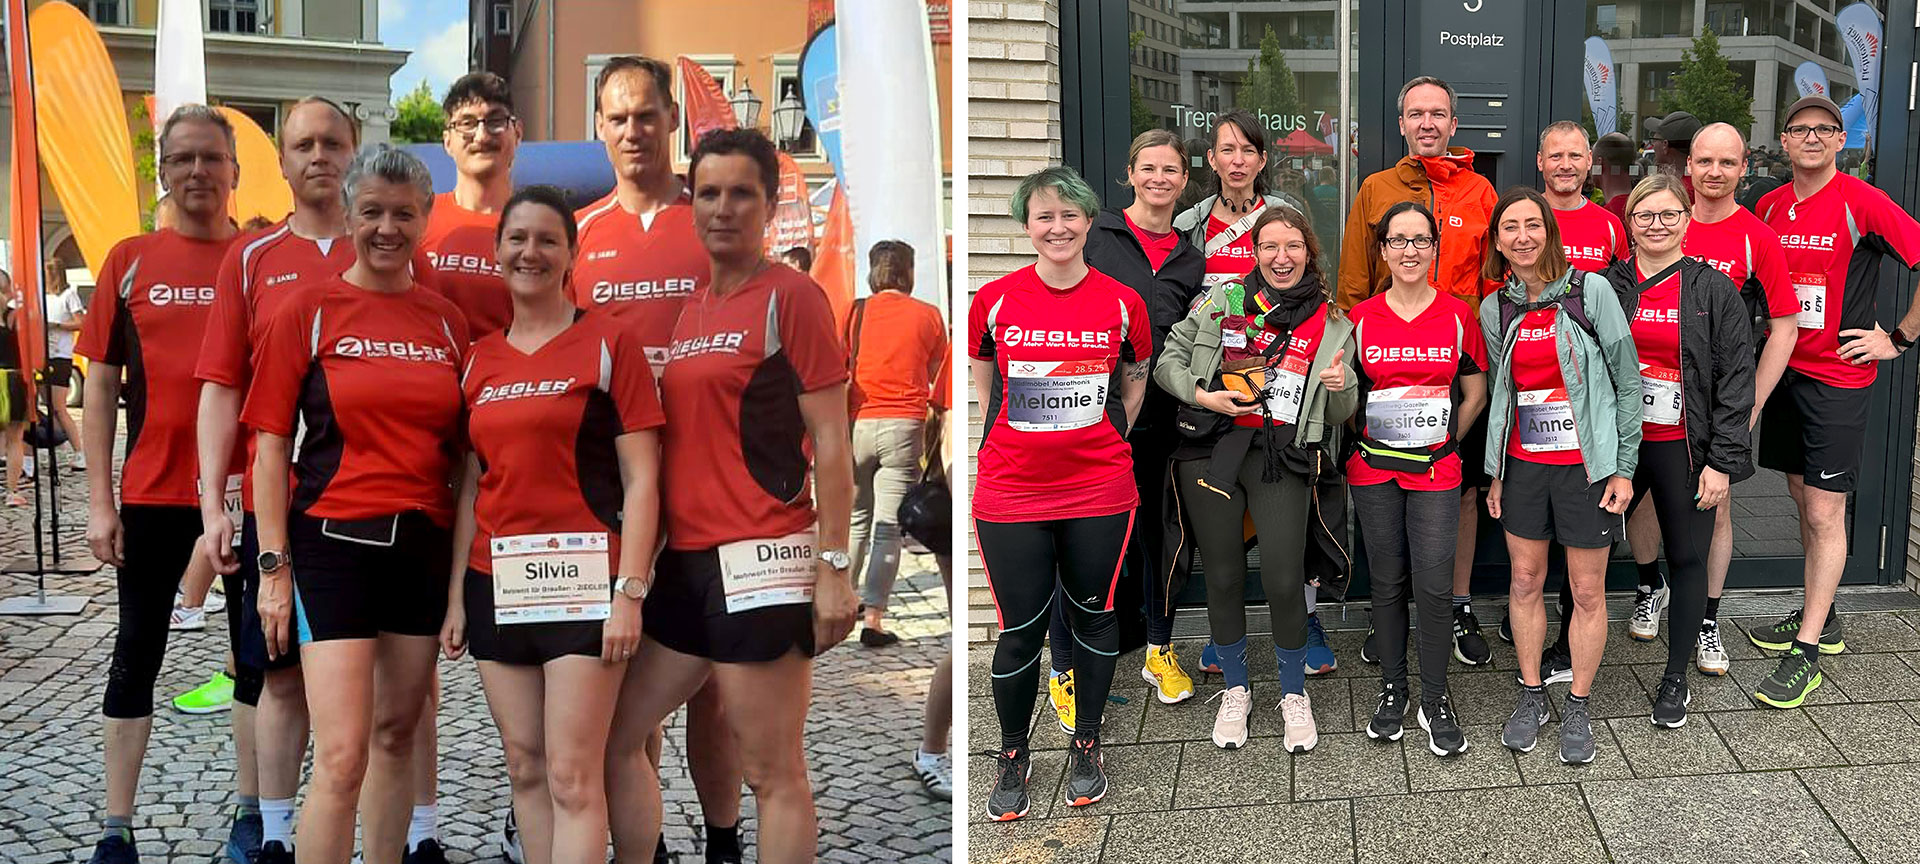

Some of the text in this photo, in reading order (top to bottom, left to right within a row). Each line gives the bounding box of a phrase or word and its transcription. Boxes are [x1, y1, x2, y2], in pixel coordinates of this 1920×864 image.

[1440, 31, 1504, 48] Postplatz
[1170, 103, 1326, 133] Trephaus 7
[149, 284, 215, 306] ZIEG
[593, 278, 696, 303] ZIEGLER
[1815, 295, 1823, 313] EFW
[1004, 325, 1110, 347] ZIEGLER
[1365, 345, 1452, 364] ZIEGLER
[1075, 364, 1105, 374] 28.5.25
[1658, 371, 1680, 380] 28.5.2
[1009, 391, 1092, 410] Melanie
[1097, 385, 1105, 406] EFW
[1269, 386, 1291, 399] arie
[1293, 385, 1302, 406] EFW
[1672, 391, 1681, 410] EFW
[1368, 410, 1438, 430] Desirée
[1441, 408, 1449, 427] EFW
[1528, 418, 1574, 433] Anne
[757, 543, 811, 563] Diana
[525, 561, 579, 580] Silvia
